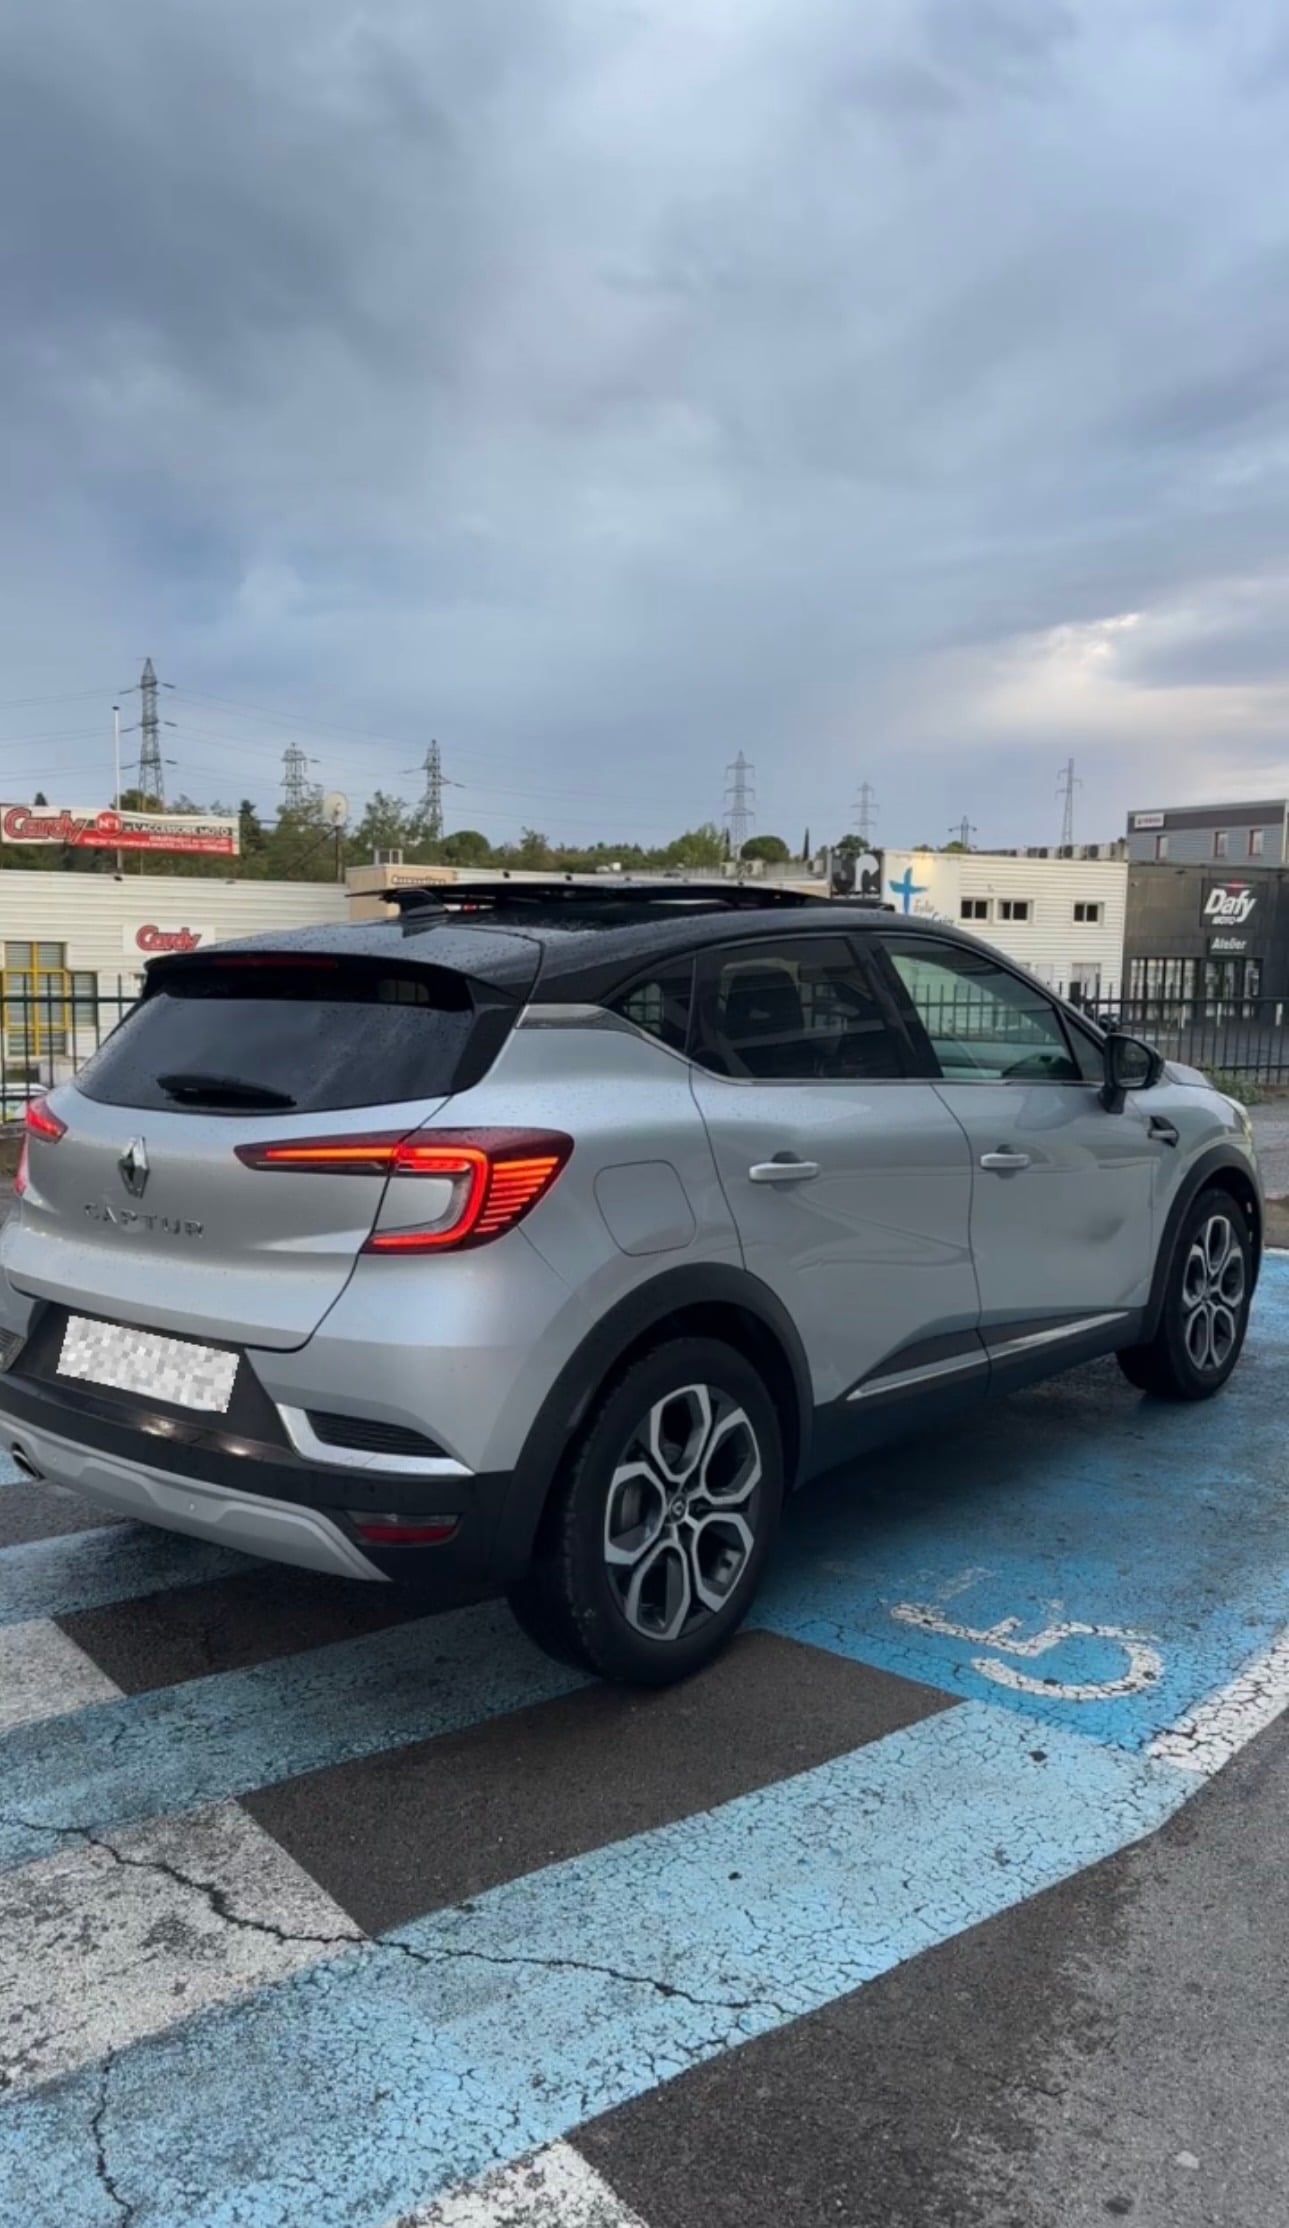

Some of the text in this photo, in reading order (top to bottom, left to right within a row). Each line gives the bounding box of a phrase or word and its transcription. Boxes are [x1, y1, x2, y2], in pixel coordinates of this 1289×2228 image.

[1204, 888, 1256, 923] Dafy
[1211, 937, 1246, 950] Atelier
[84, 1202, 204, 1239] CAPTUR
